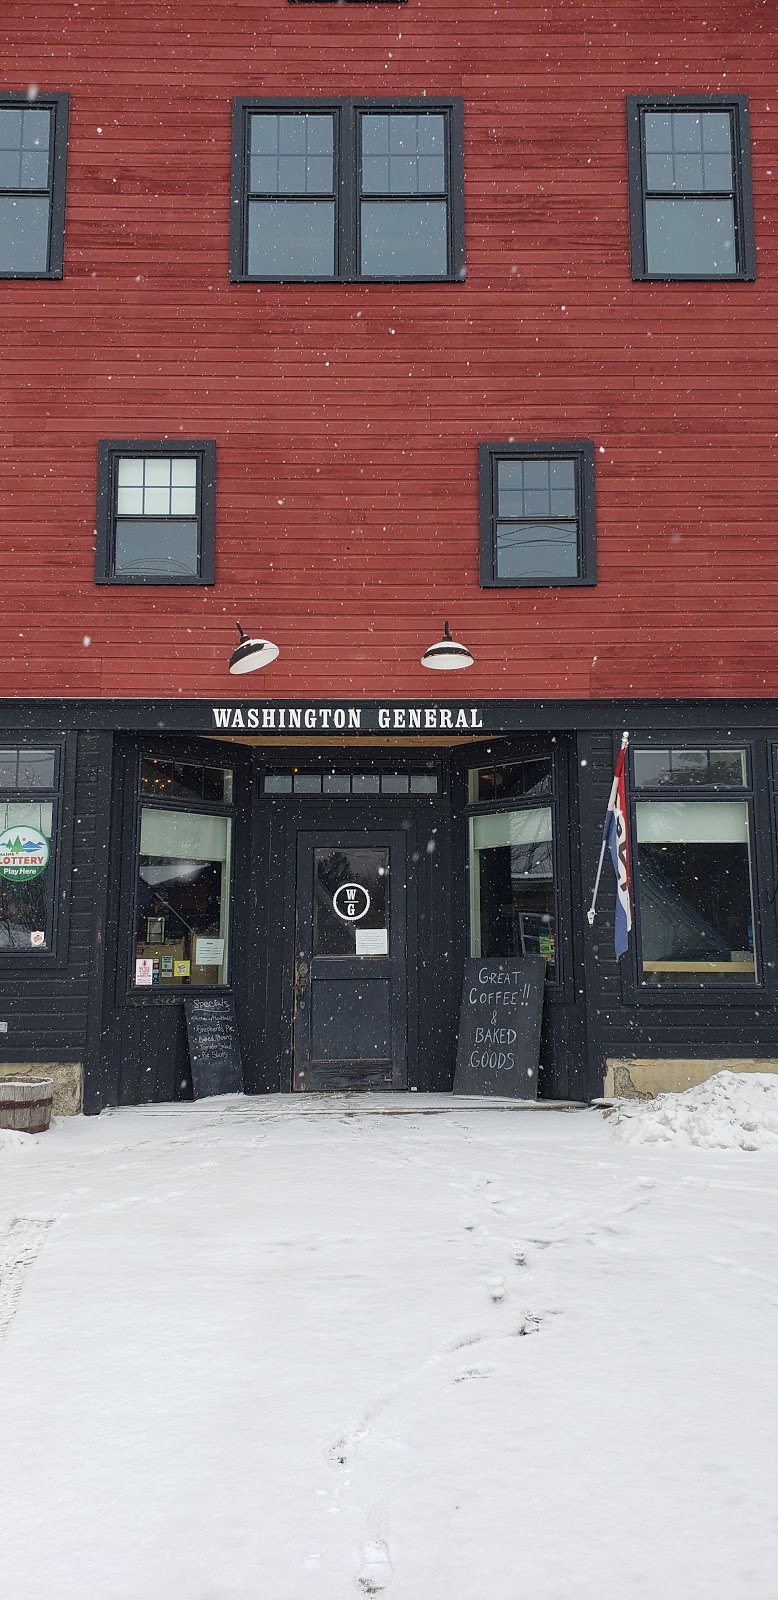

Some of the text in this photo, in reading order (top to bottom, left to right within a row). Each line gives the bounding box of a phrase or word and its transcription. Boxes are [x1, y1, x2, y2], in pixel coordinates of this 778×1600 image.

[212, 708, 483, 729] WASHINGTON GENERAL
[346, 889, 357, 900] W
[347, 904, 355, 916] G
[478, 967, 522, 984] GREAT
[193, 998, 230, 1009] Specials
[491, 1010, 497, 1025] &
[475, 1027, 517, 1044] BAKED
[470, 1050, 515, 1070] GOODS
